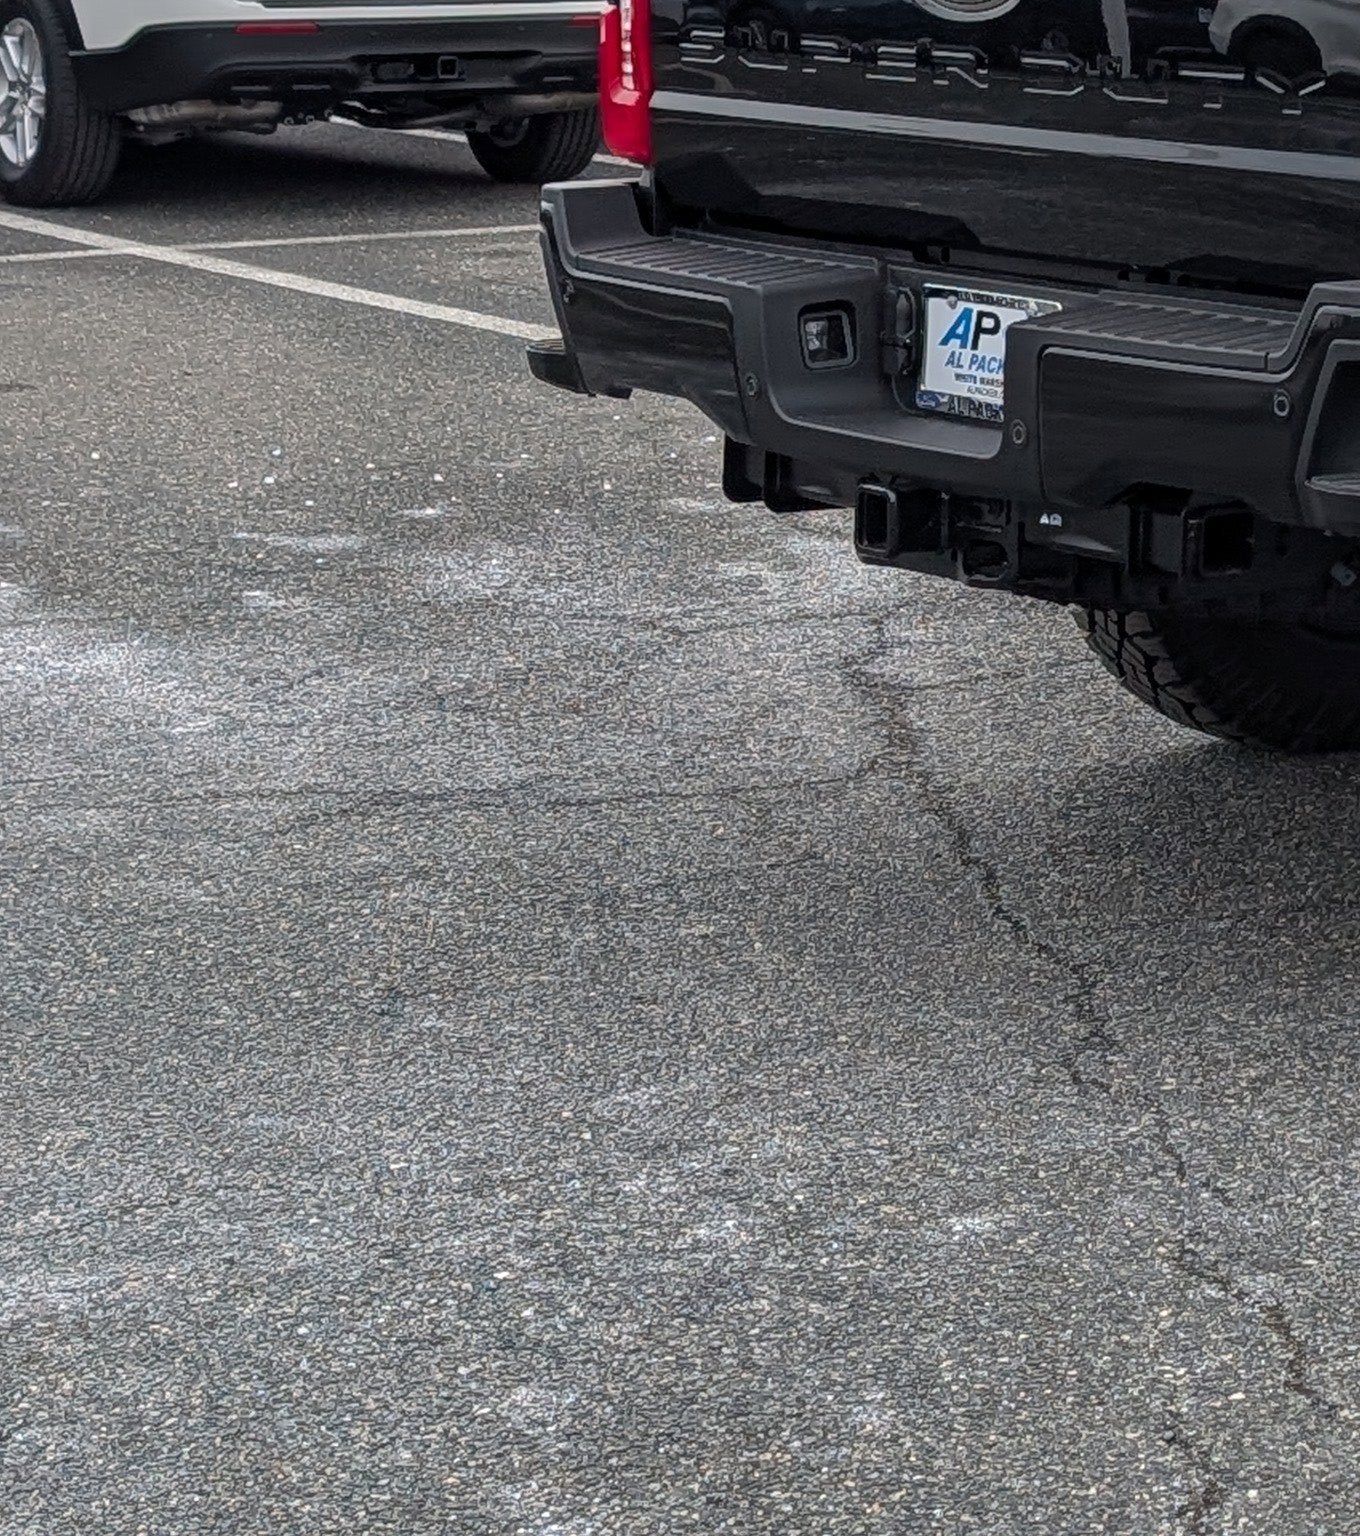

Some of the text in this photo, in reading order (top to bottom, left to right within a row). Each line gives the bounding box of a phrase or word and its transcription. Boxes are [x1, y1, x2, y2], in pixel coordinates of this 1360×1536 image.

[677, 22, 1328, 116] SUPER DUTY
[938, 306, 1002, 351] AP
[944, 350, 964, 369] AL
